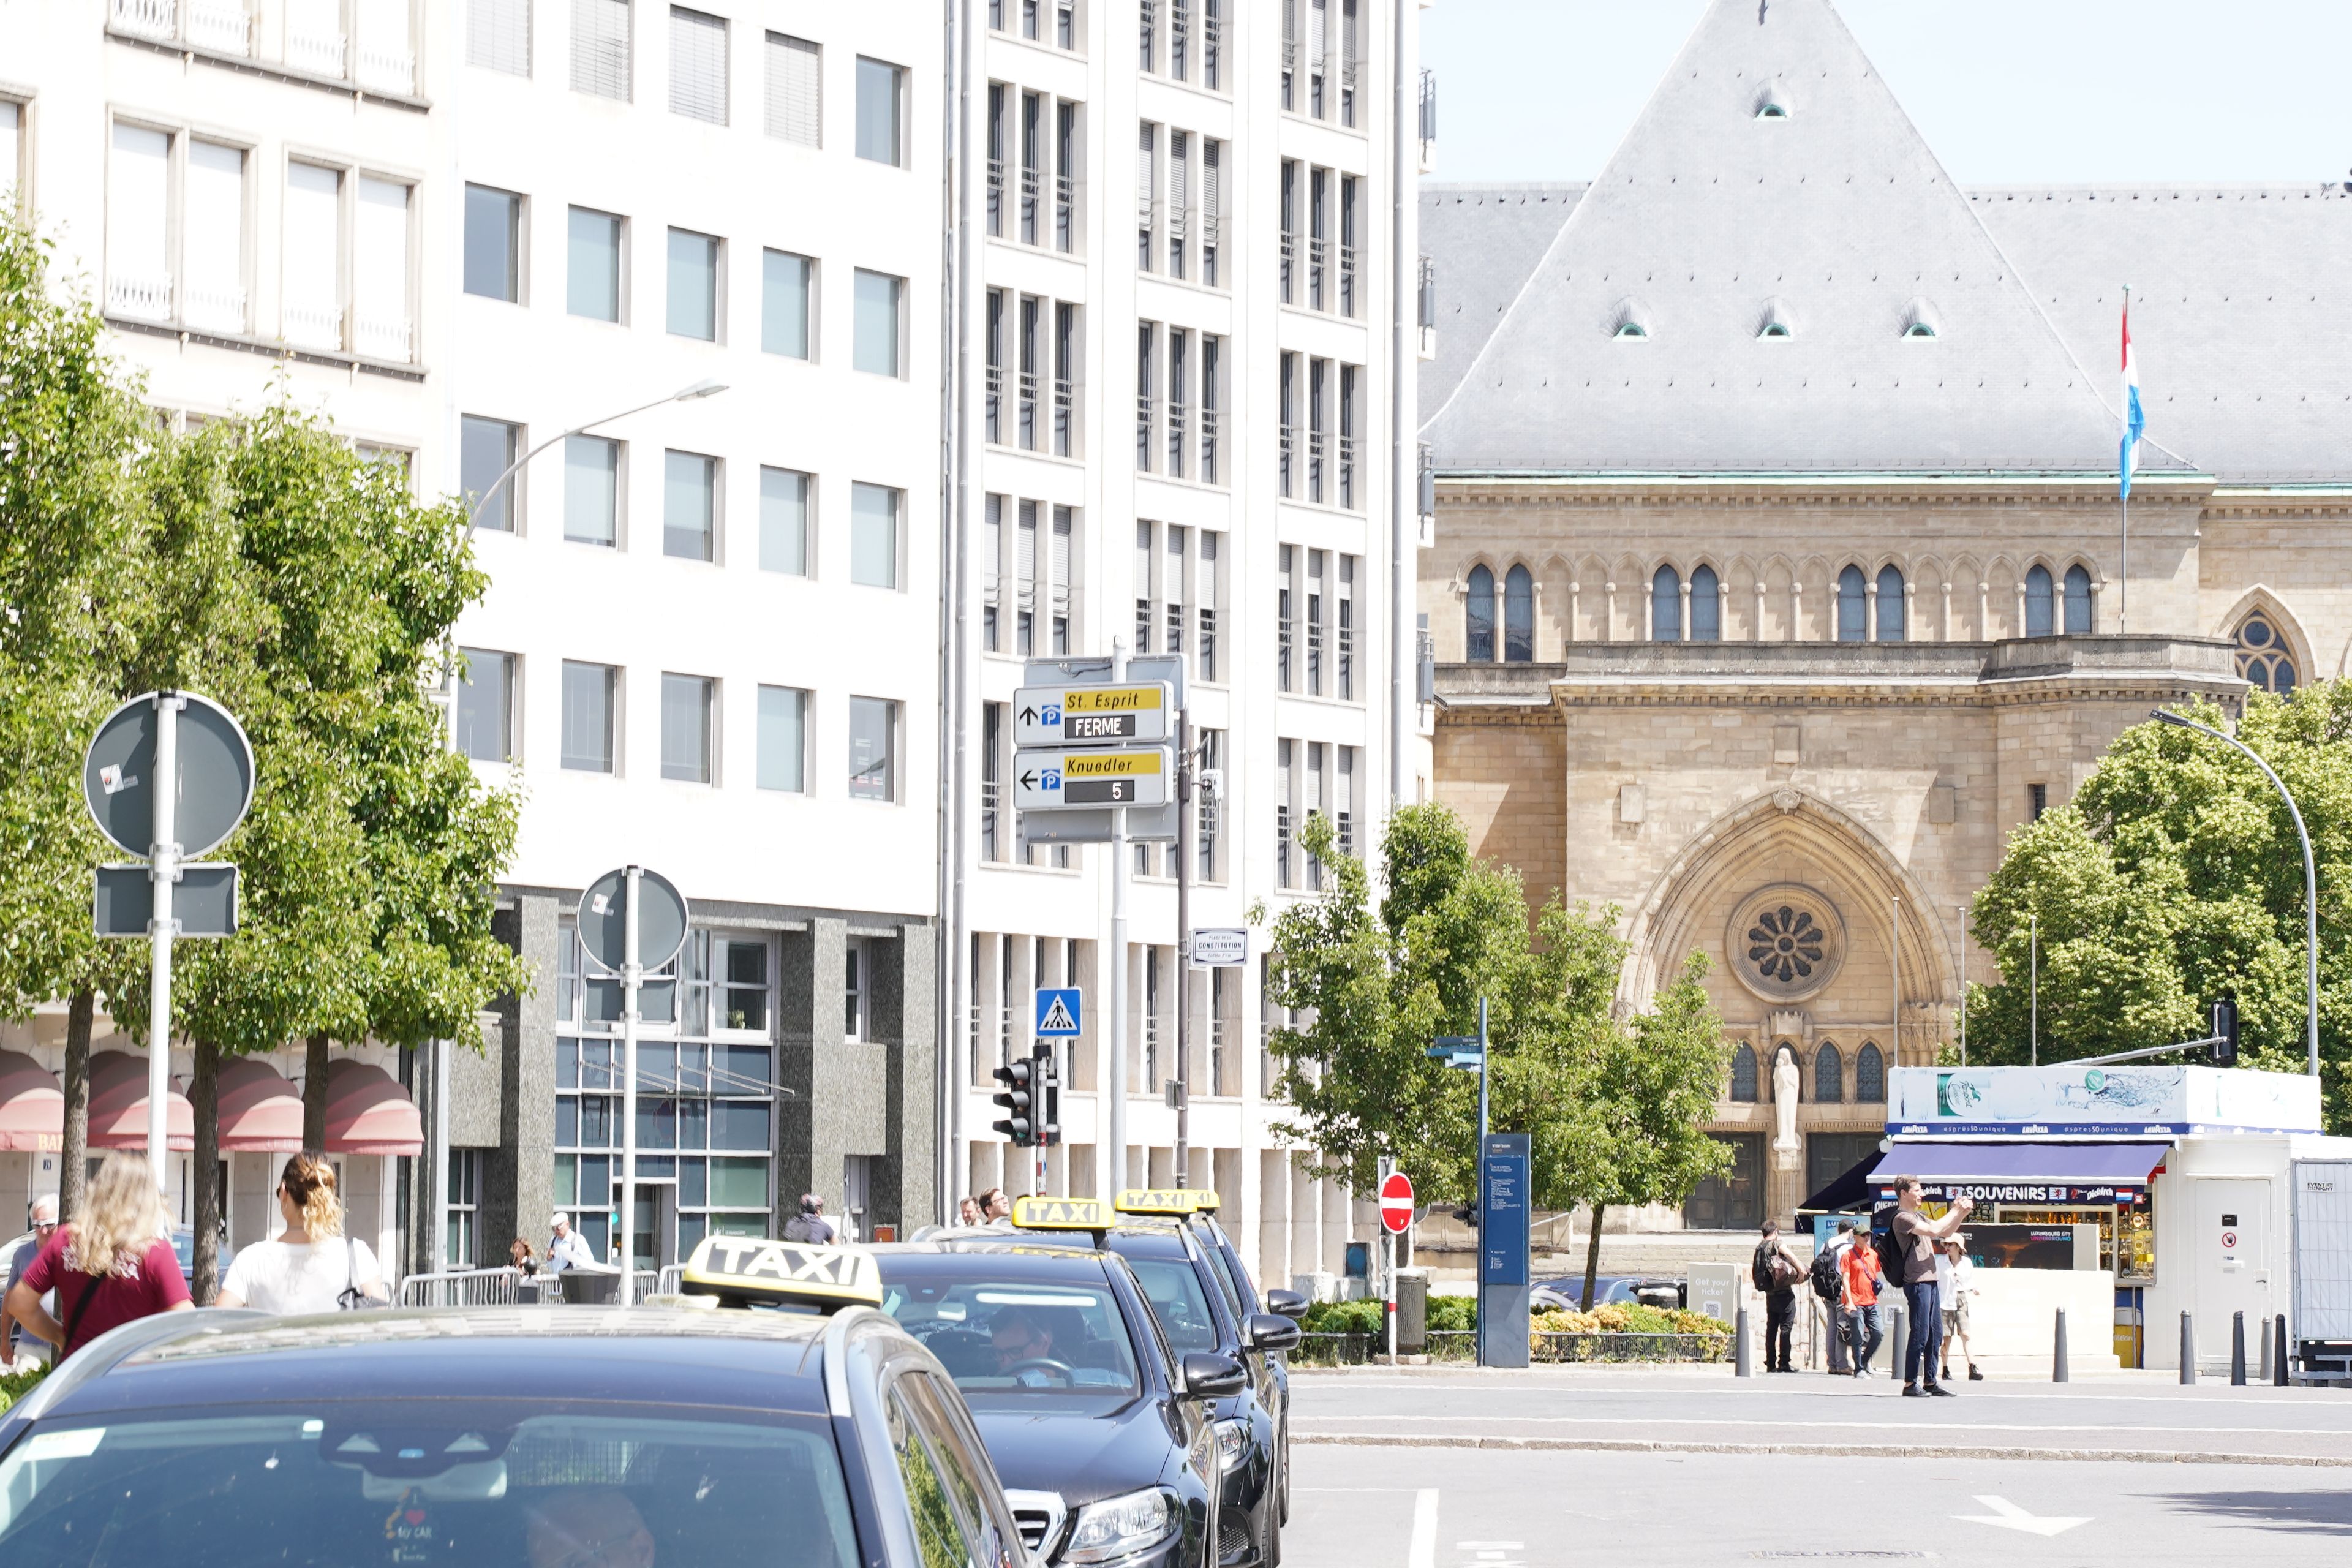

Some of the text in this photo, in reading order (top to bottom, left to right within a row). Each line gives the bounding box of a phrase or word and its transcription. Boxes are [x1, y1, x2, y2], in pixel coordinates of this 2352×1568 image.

[1068, 693, 1139, 710] St. Esprit
[1075, 717, 1123, 736] FERME
[1068, 759, 1133, 774] Knuedler
[1112, 782, 1122, 800] 5
[1901, 1125, 1928, 1133] LAVAZZA
[2022, 1125, 2049, 1133] LAVAZZA
[2144, 1125, 2171, 1133] LAVAZZA
[1129, 1193, 1182, 1207] TAXI
[1966, 1186, 2046, 1201] SOUVENIRS
[1028, 1202, 1099, 1223] TAXI
[714, 1243, 854, 1285] TAXI
[1711, 1279, 1730, 1288] your
[1882, 1291, 1905, 1300] ticket
